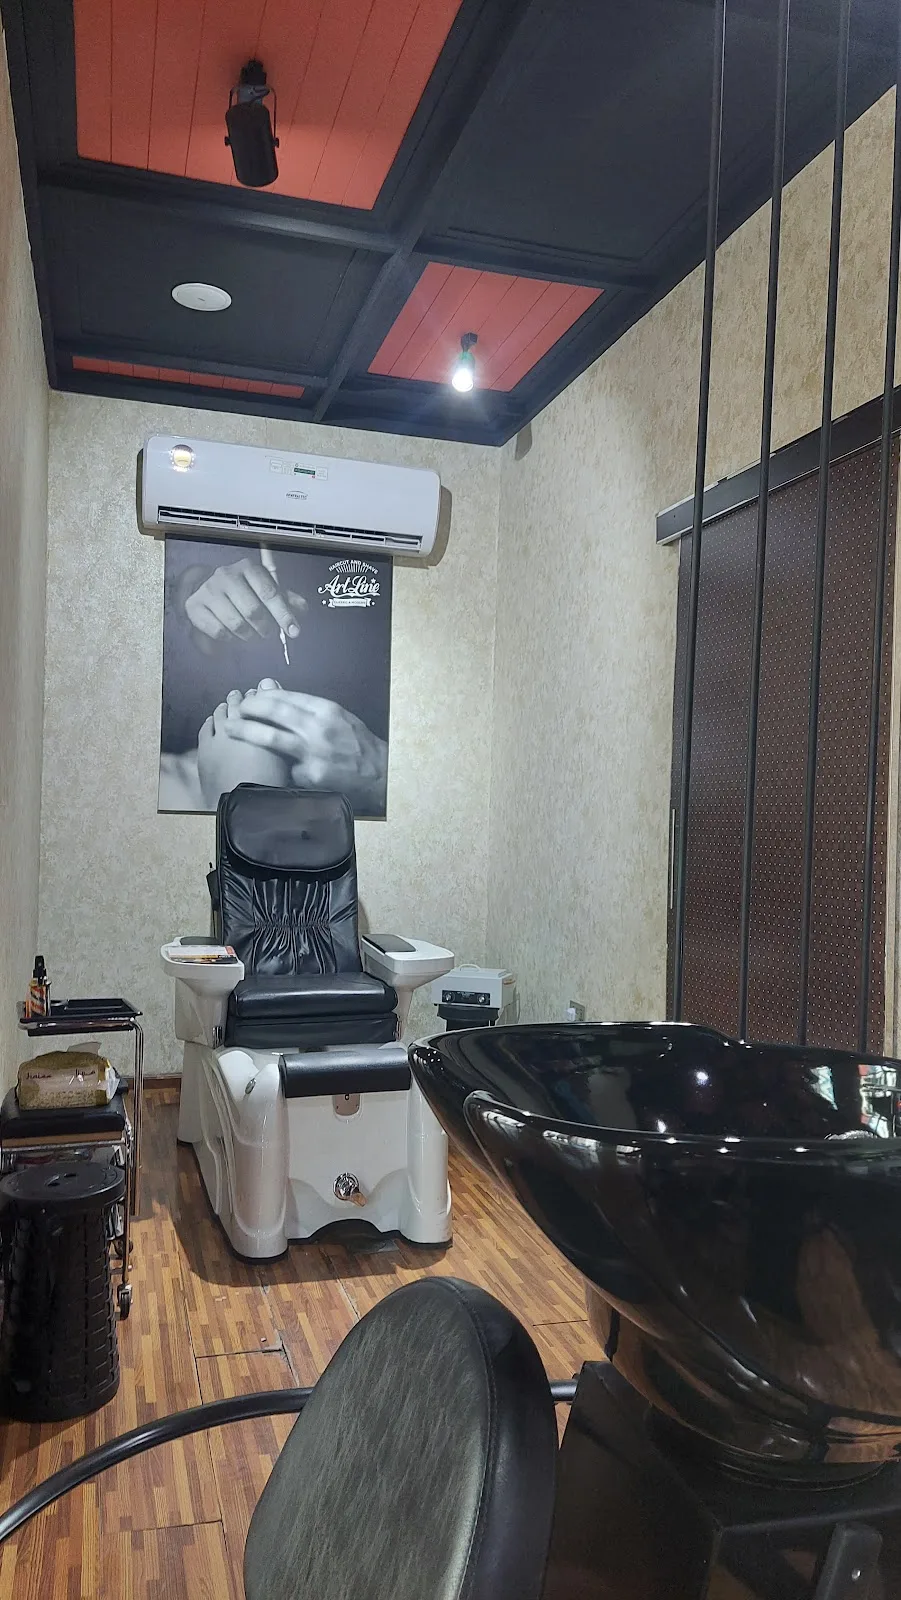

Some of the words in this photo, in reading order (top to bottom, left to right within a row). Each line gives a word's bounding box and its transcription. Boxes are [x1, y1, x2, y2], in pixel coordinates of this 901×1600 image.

[328, 560, 350, 571] HAIRCUT
[362, 562, 379, 574] SHAVE
[317, 574, 351, 597] Art
[351, 575, 380, 597] Line
